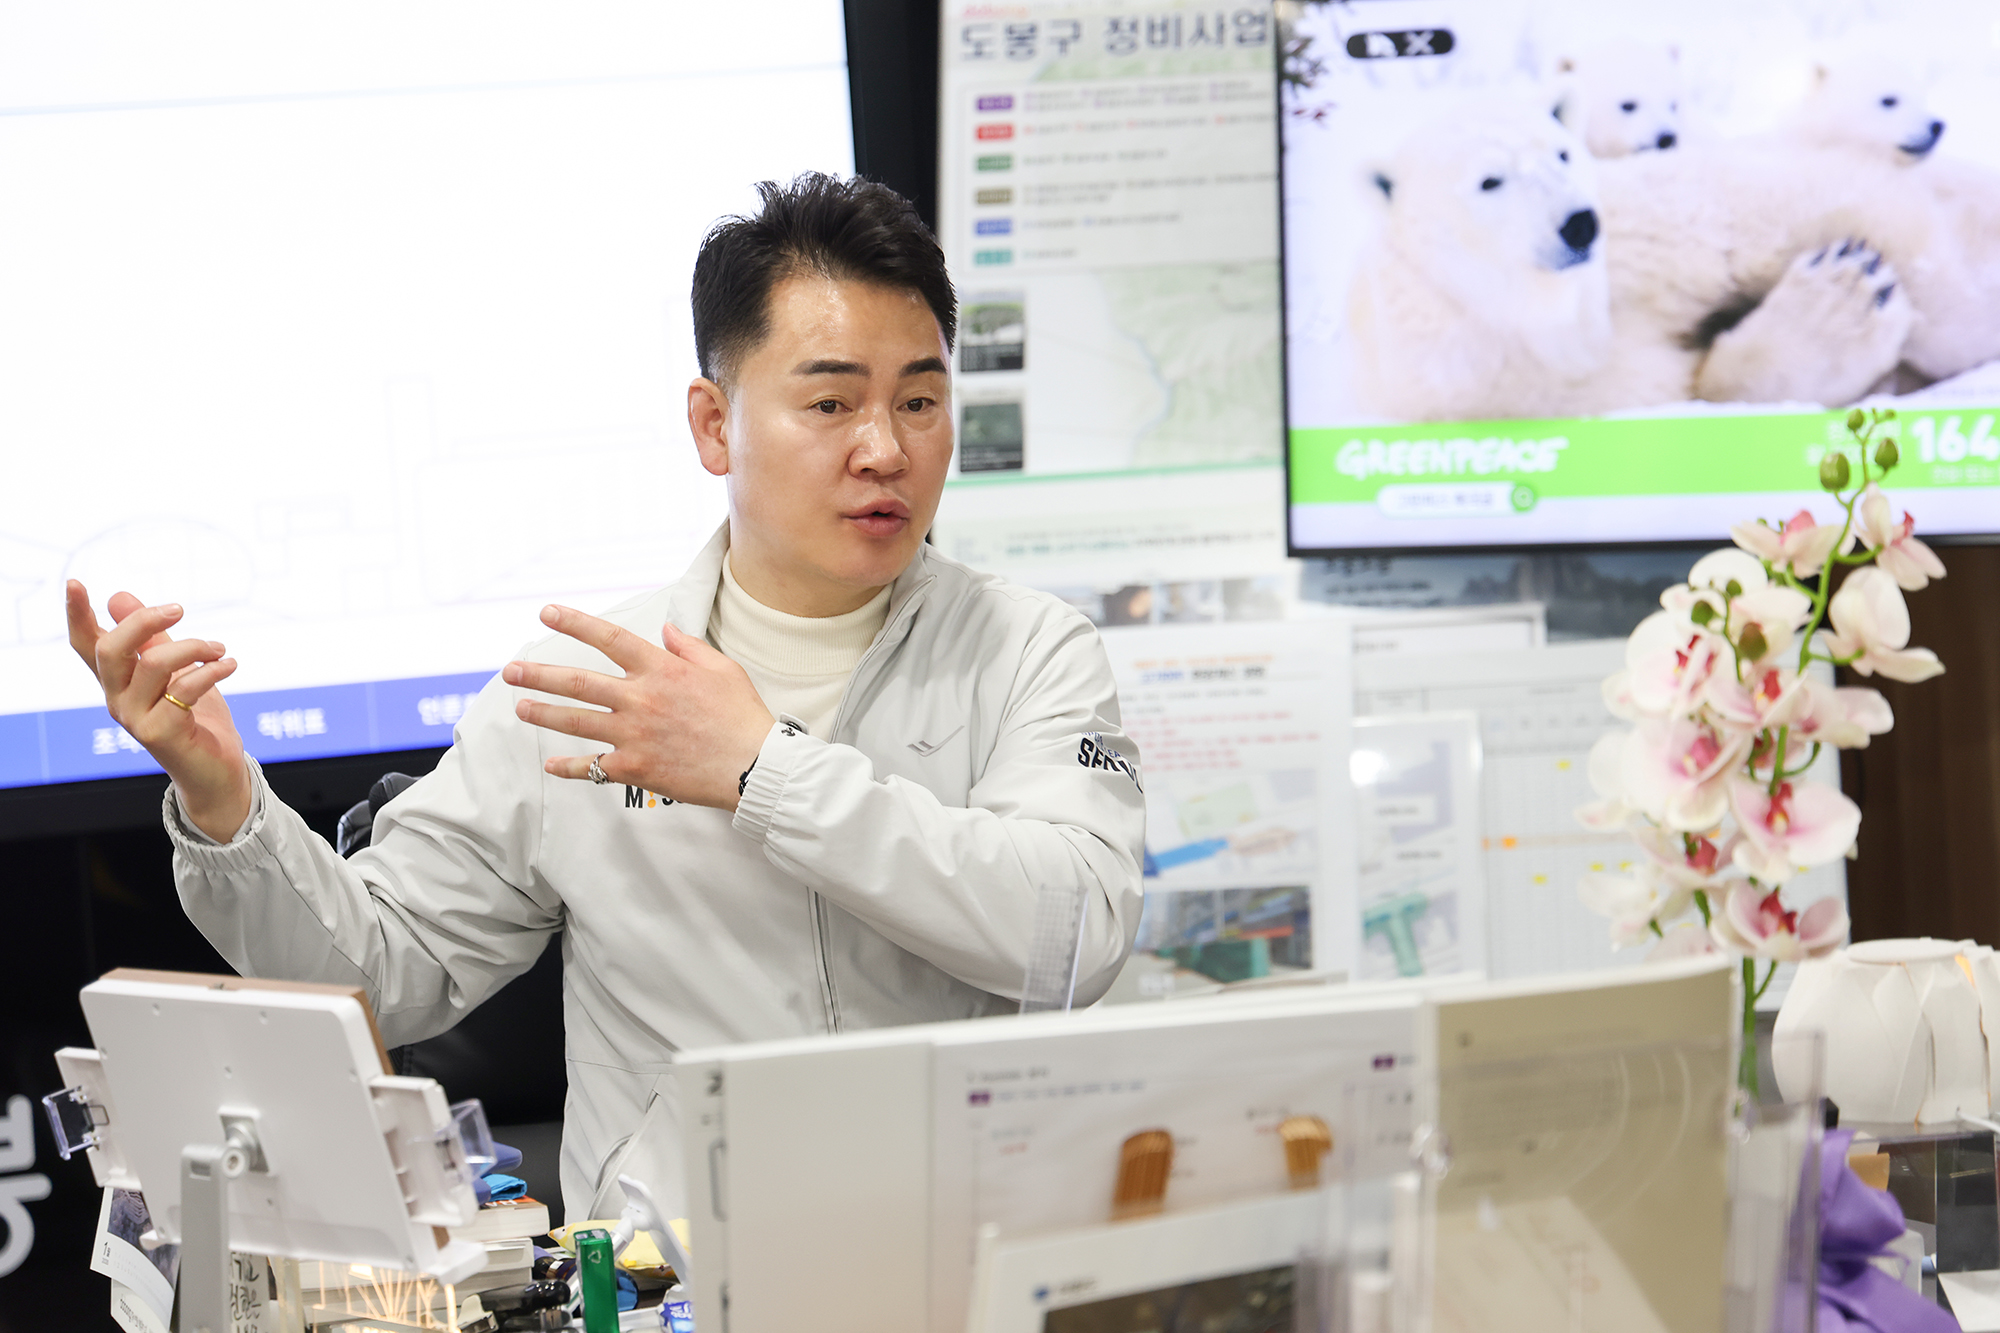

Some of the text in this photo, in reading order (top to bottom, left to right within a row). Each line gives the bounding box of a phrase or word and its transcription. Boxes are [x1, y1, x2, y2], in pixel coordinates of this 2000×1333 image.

[961, 11, 1268, 61] 도봉구 정비사업
[1335, 436, 1570, 481] GREENPEACE
[1912, 414, 2000, 463] 164
